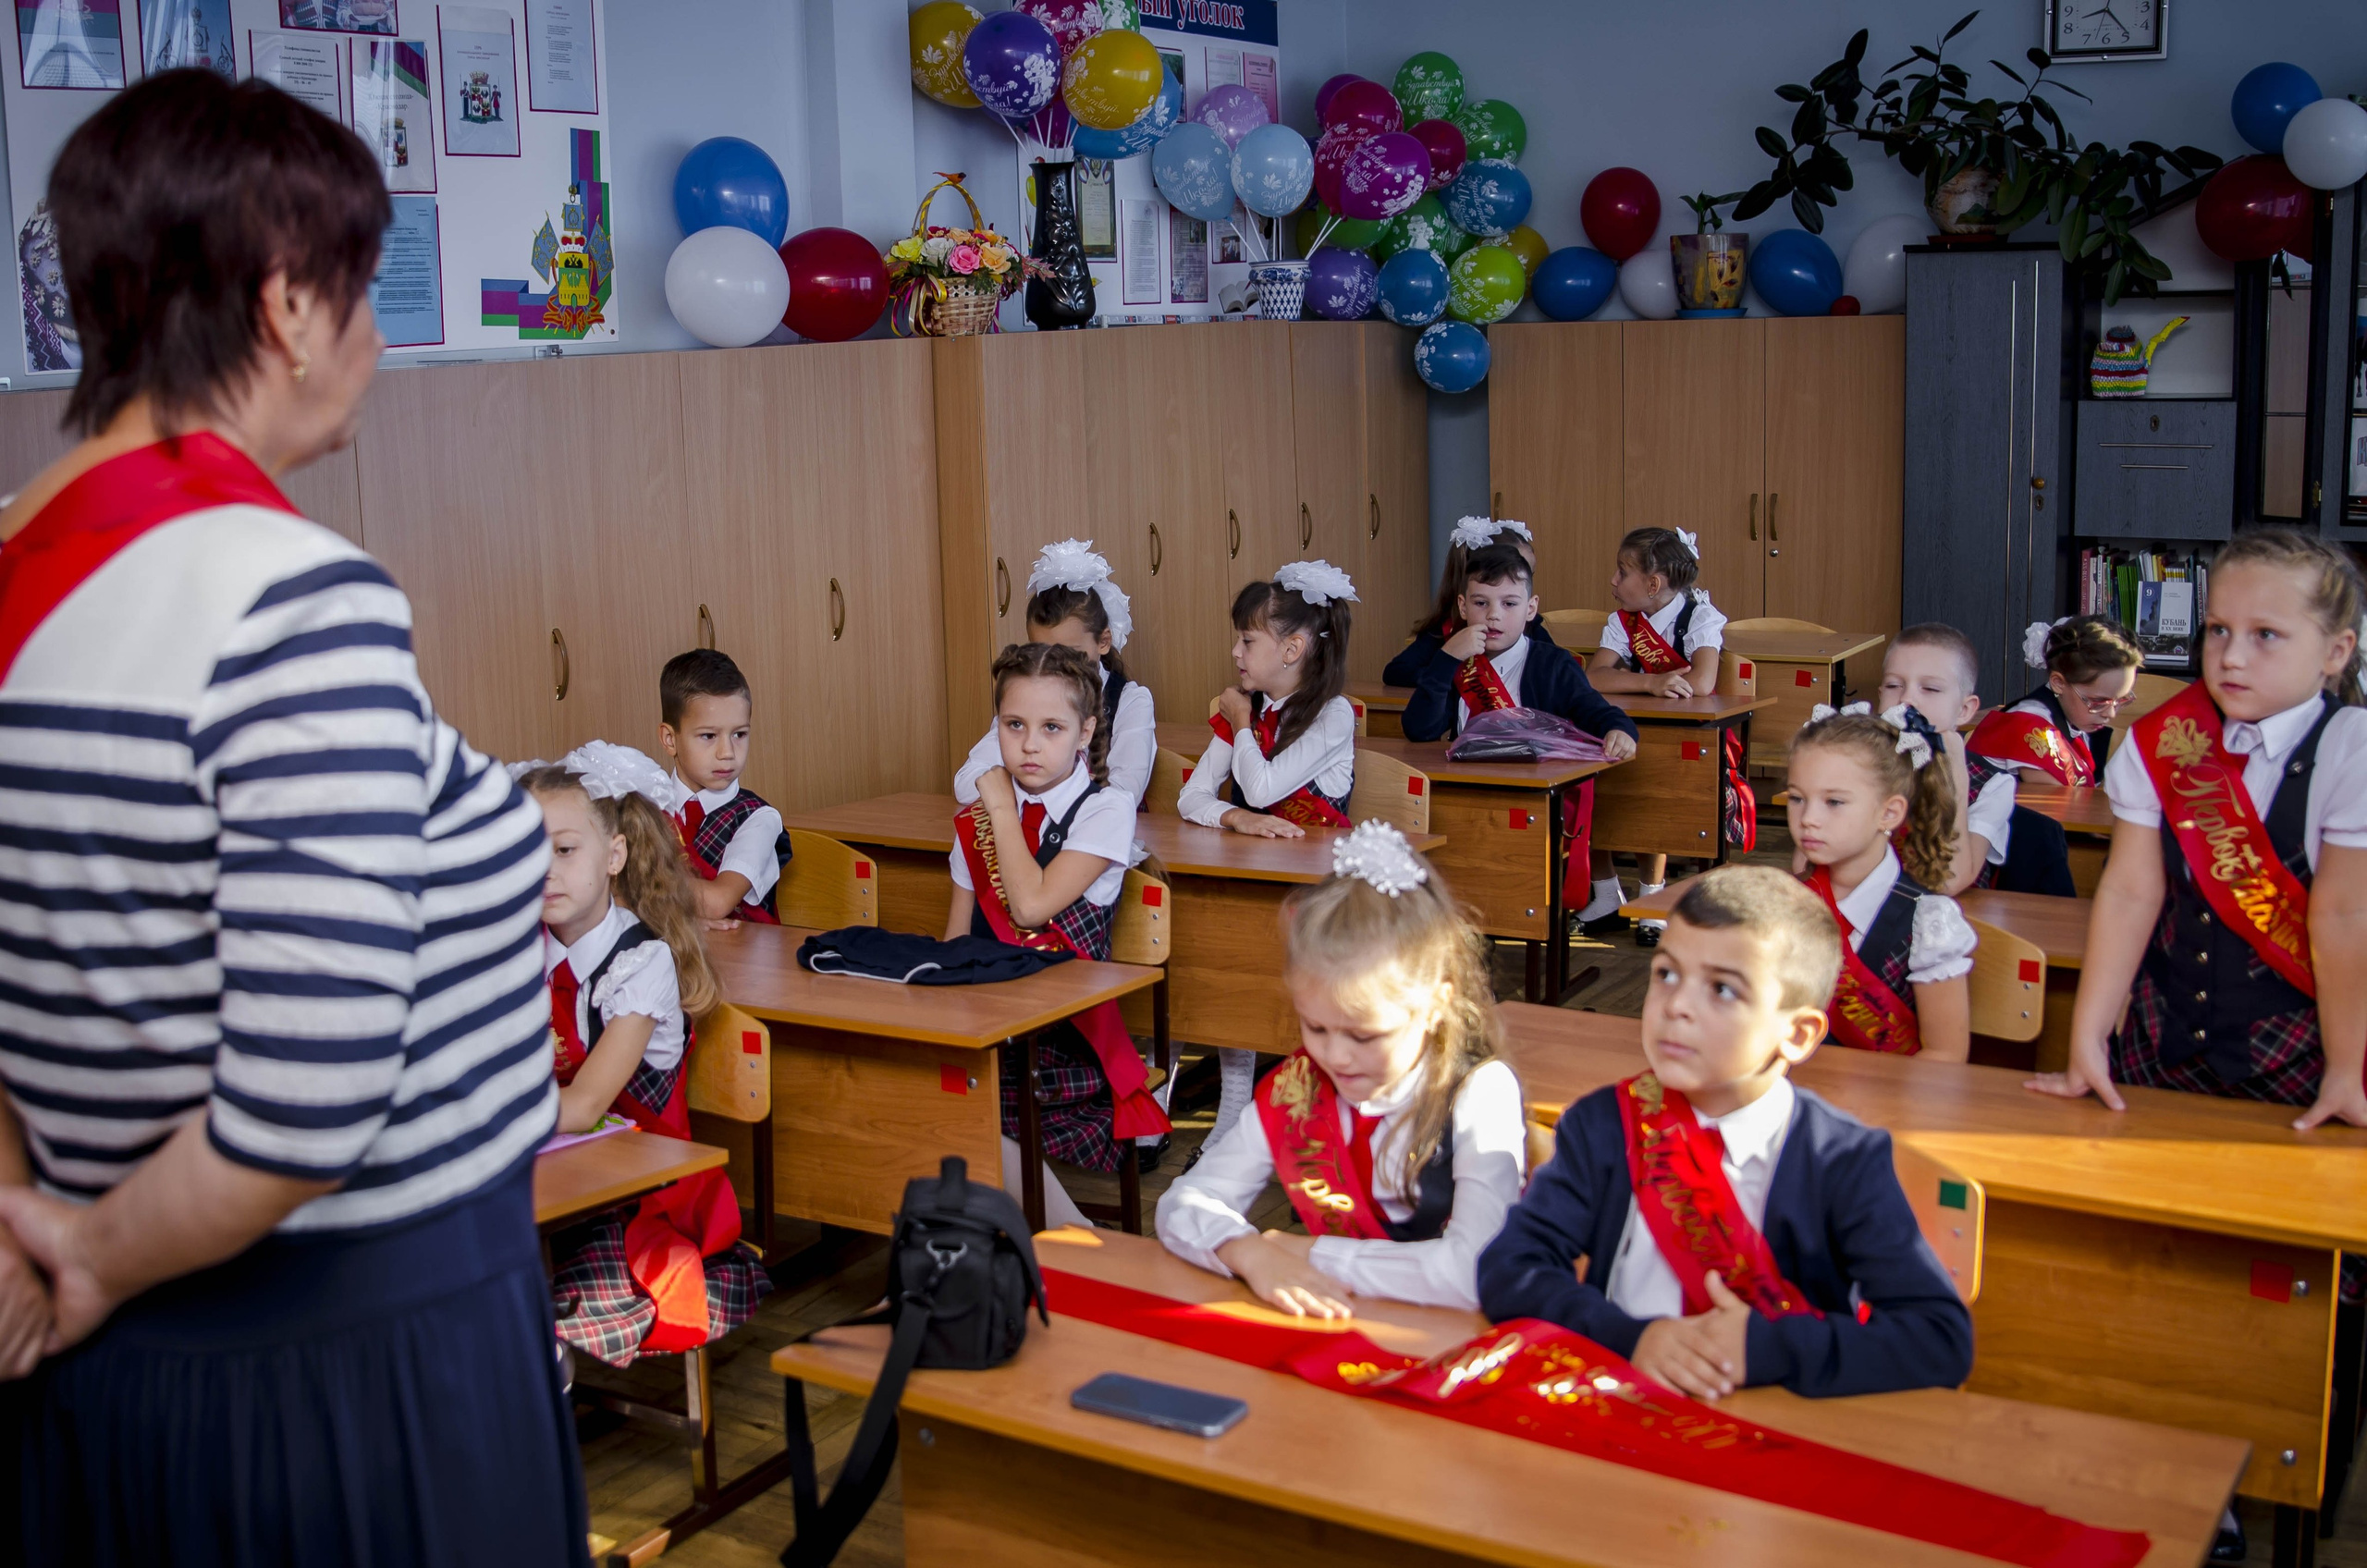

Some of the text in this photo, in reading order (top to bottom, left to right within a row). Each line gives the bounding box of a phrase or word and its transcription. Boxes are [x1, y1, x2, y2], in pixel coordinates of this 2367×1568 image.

[1134, 0, 1245, 30] ый уголок
[2064, 6, 2073, 18] 9
[2063, 22, 2073, 34] 8
[2140, 18, 2150, 31] 4
[2081, 33, 2091, 45] 7
[2101, 32, 2111, 44] 6
[2120, 31, 2130, 43] 5
[2146, 588, 2153, 597] 9
[2162, 619, 2187, 627] КУБАНЬ
